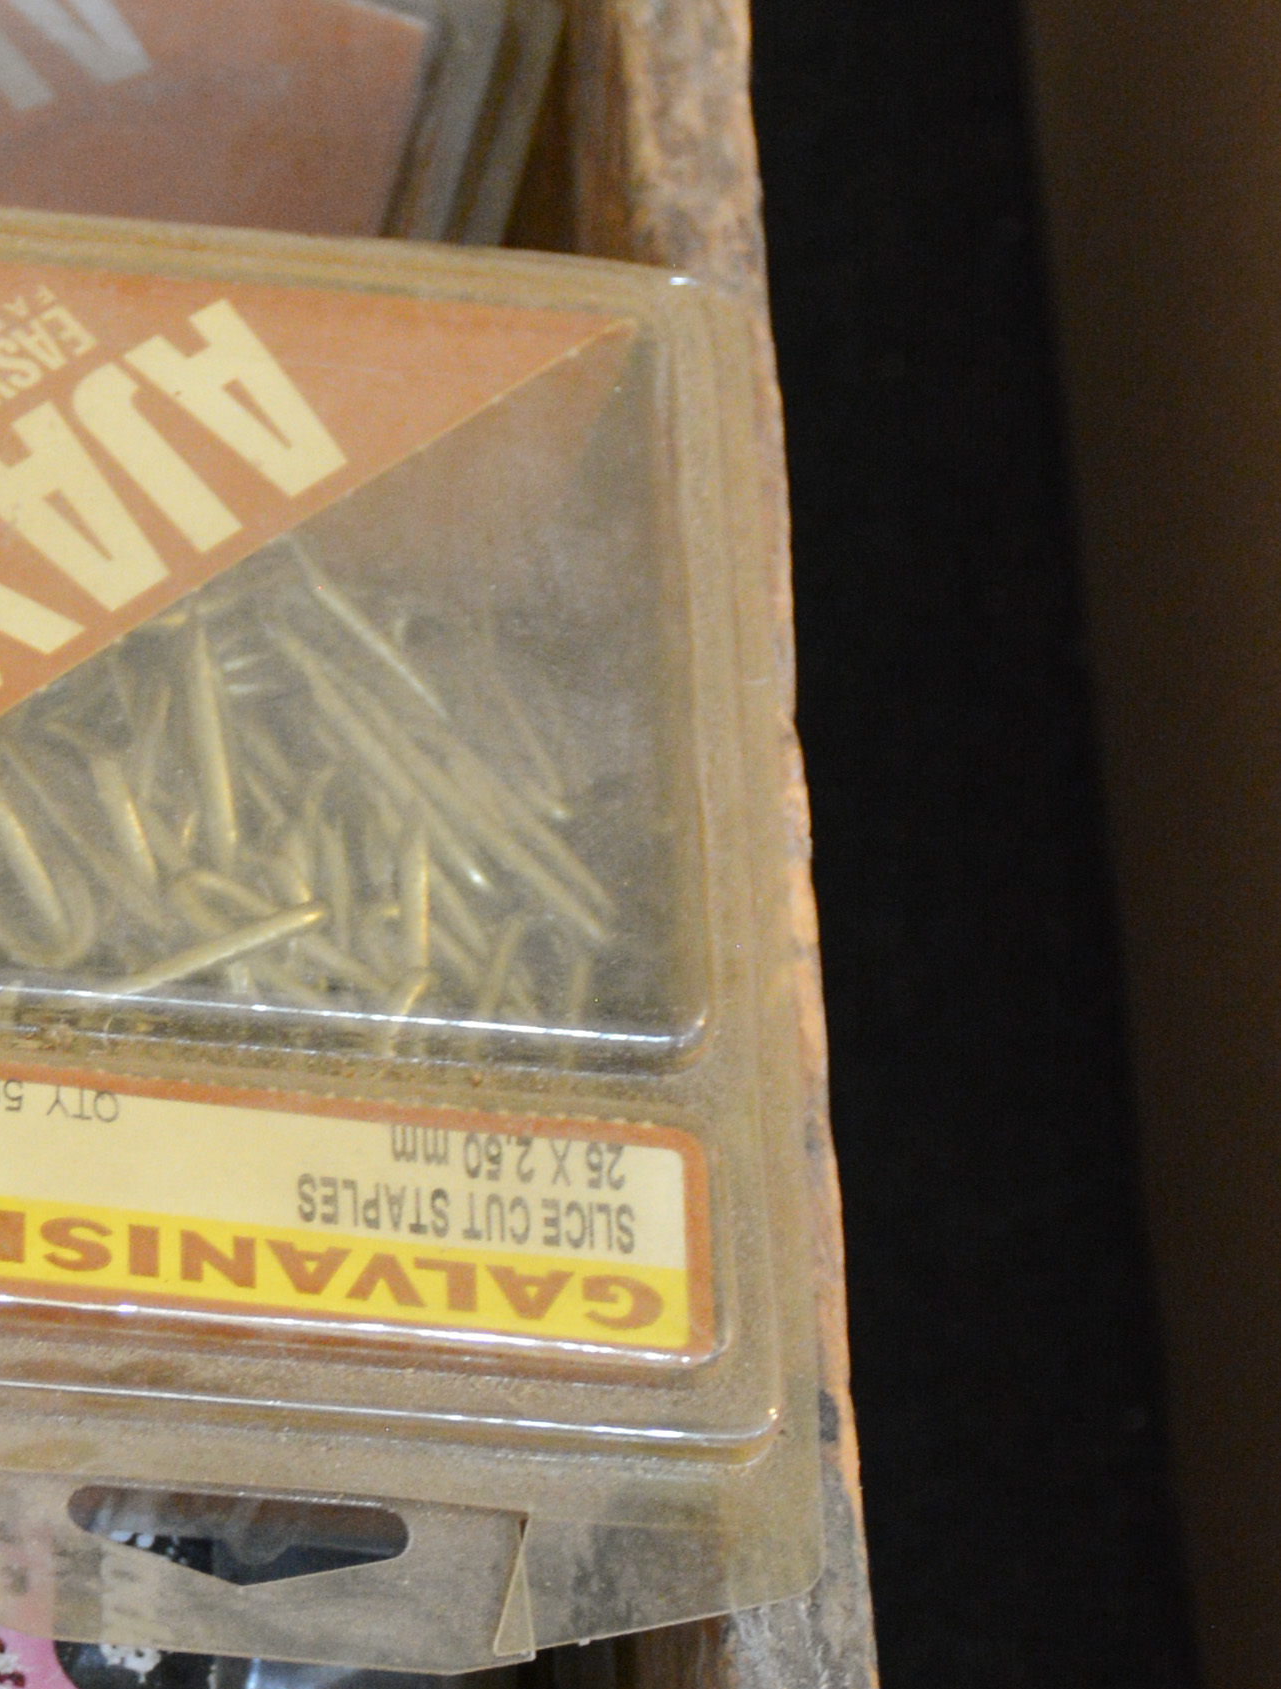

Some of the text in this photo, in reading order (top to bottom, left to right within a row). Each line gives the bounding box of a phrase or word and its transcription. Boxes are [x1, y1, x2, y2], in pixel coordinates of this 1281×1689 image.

[45, 1084, 120, 1124] QTY
[390, 1123, 450, 1165] mm
[548, 1136, 572, 1188] X
[584, 1139, 626, 1192] 25
[296, 1172, 636, 1255] SLICE CUT STAPLES
